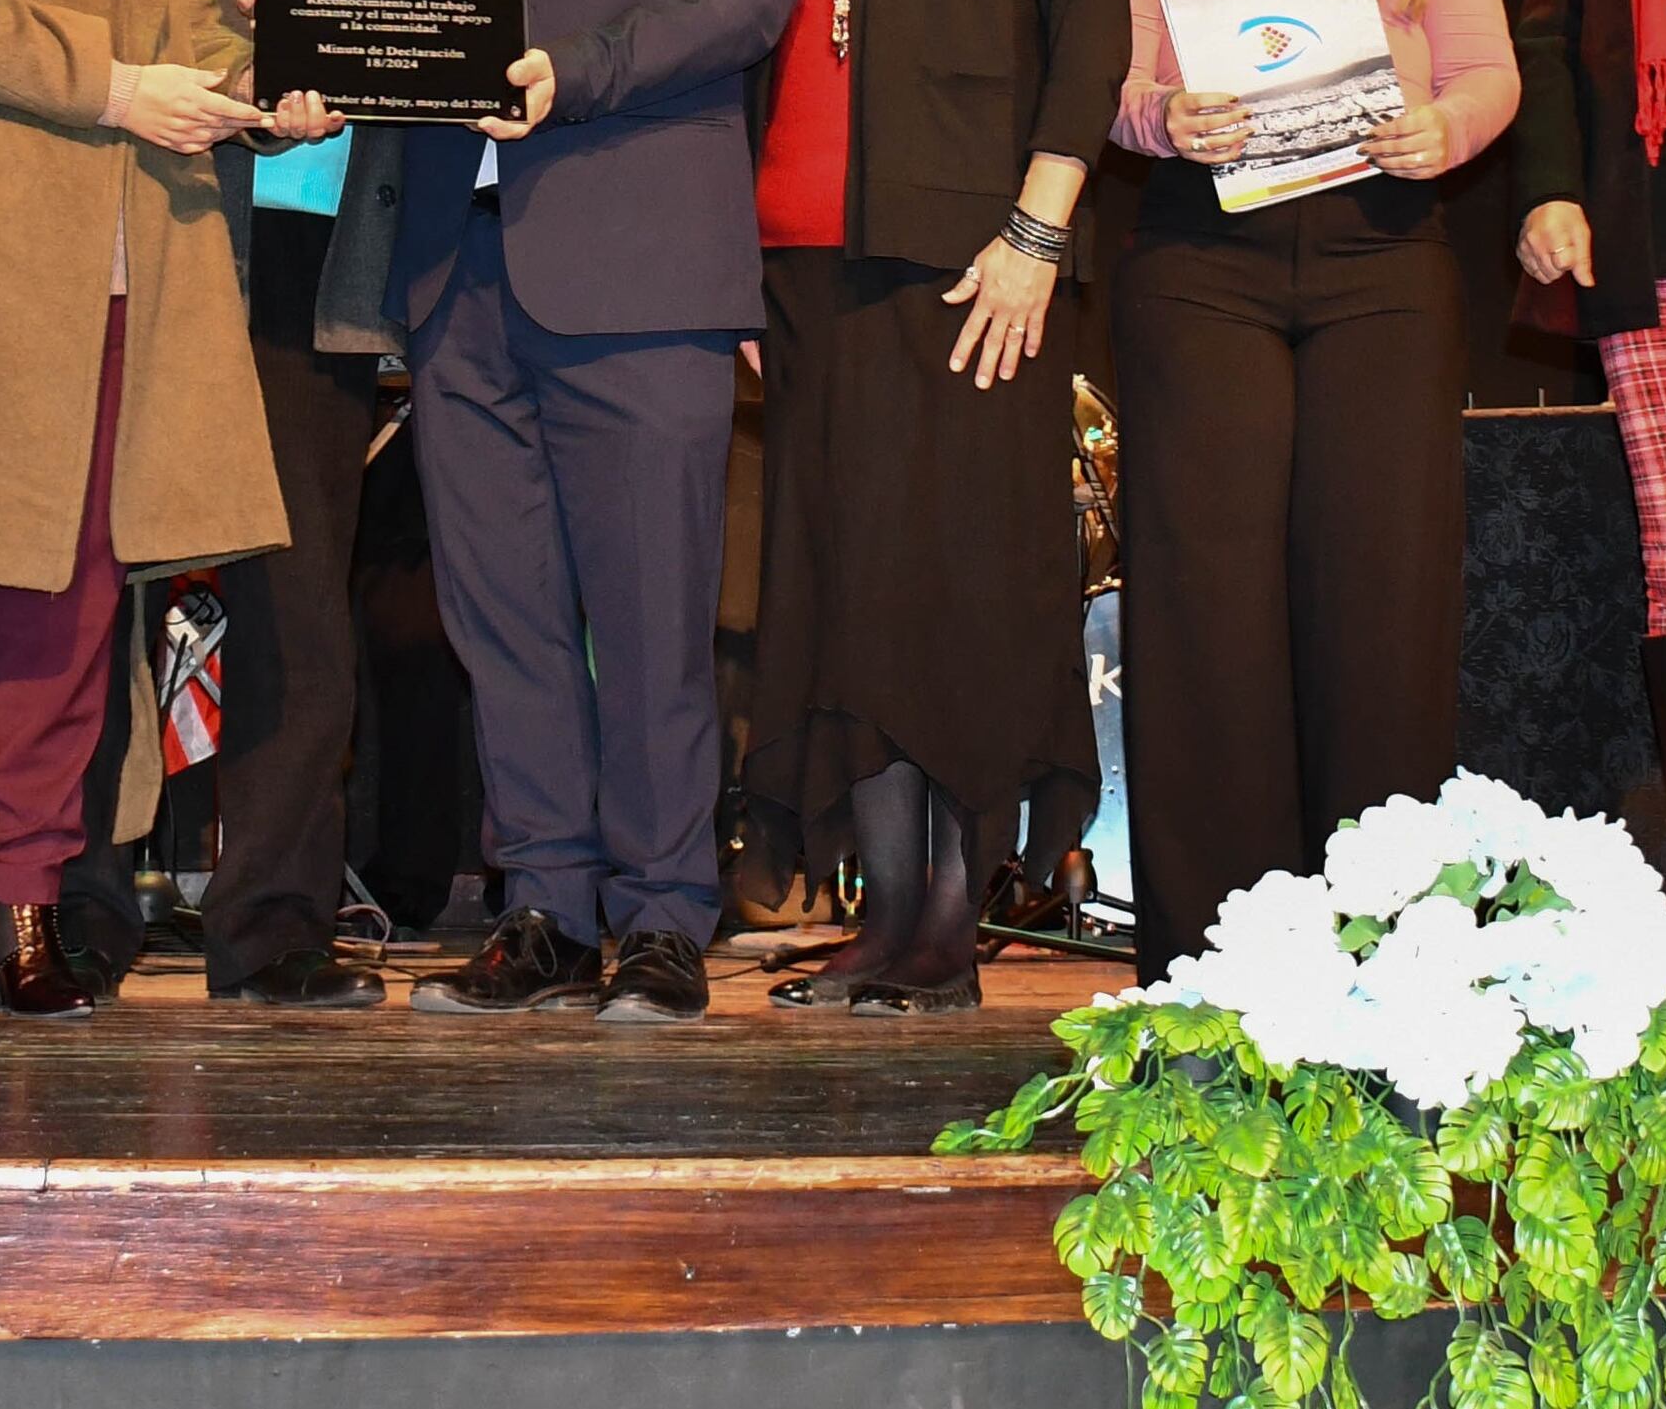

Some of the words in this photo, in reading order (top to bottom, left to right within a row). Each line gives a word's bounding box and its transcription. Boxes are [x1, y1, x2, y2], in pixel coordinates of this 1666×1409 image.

[415, 0, 428, 10] al
[430, 1, 477, 13] trabajo
[290, 7, 353, 18] constante
[355, 11, 364, 20] y
[365, 9, 379, 20] el
[381, 11, 450, 23] invaluable
[452, 14, 492, 26] apoyo
[340, 22, 349, 30] a
[351, 21, 364, 31] la
[365, 23, 443, 34] comunidad.
[317, 43, 366, 55] Minuta
[367, 45, 384, 56] de
[386, 46, 466, 59] Declaración
[365, 57, 420, 69] 18/2024
[361, 95, 376, 105] de
[379, 96, 414, 108] Jujuy,
[416, 98, 449, 109] mayo
[450, 98, 469, 108] del
[471, 98, 501, 109] 2024
